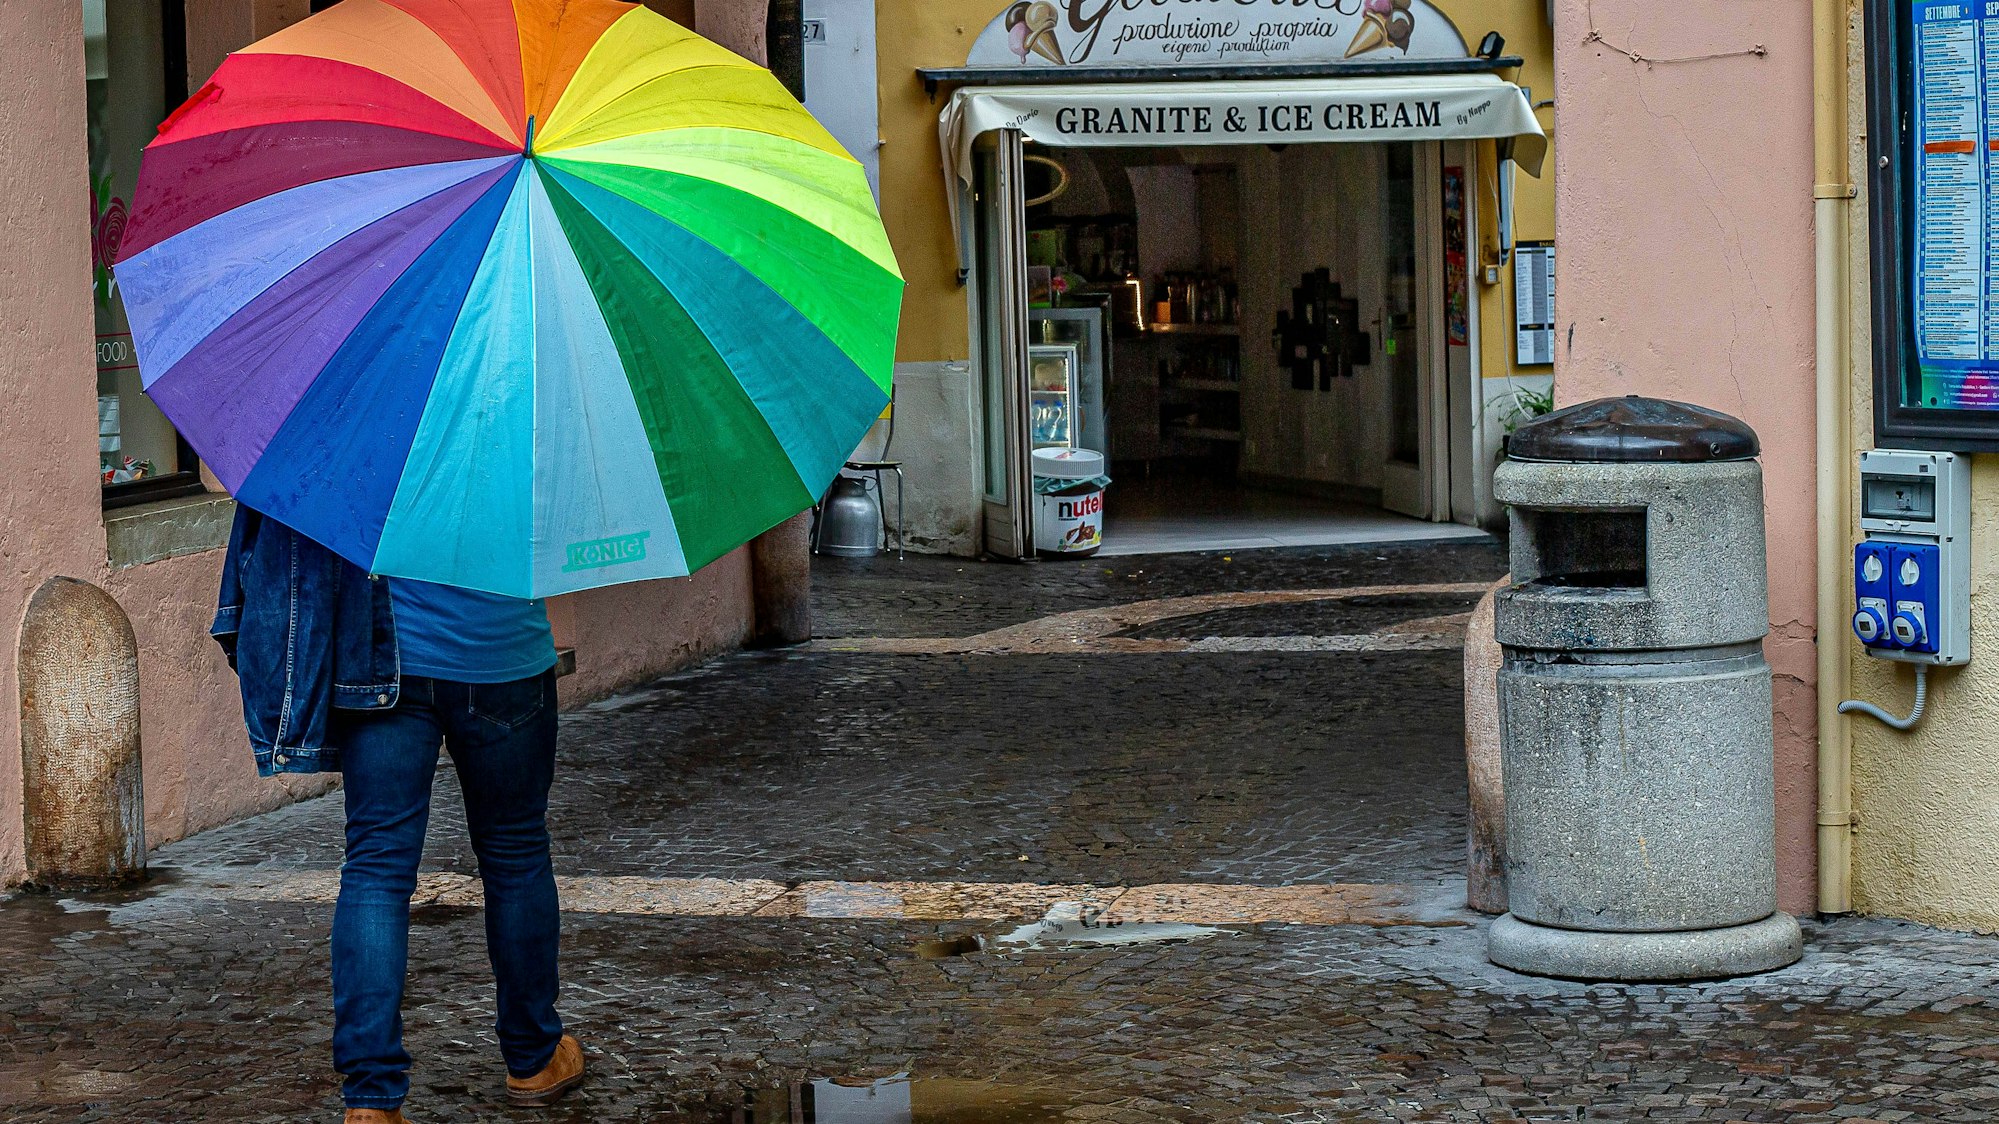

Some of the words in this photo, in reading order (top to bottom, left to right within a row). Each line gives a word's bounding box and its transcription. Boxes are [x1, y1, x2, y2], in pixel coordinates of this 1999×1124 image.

[1925, 5, 1961, 20] SETTEMBRE
[1113, 13, 1239, 55] produzione
[1250, 17, 1338, 42] propria
[1162, 40, 1210, 62] eigene
[1217, 37, 1290, 59] produktion
[1016, 109, 1039, 125] Dario
[1055, 107, 1212, 134] GRANITE
[1223, 106, 1247, 132] &
[1258, 105, 1313, 132] ICE
[1323, 101, 1442, 130] CREAM
[1456, 115, 1468, 126] By
[1468, 100, 1491, 118] Nappo
[97, 341, 127, 363] FOOD
